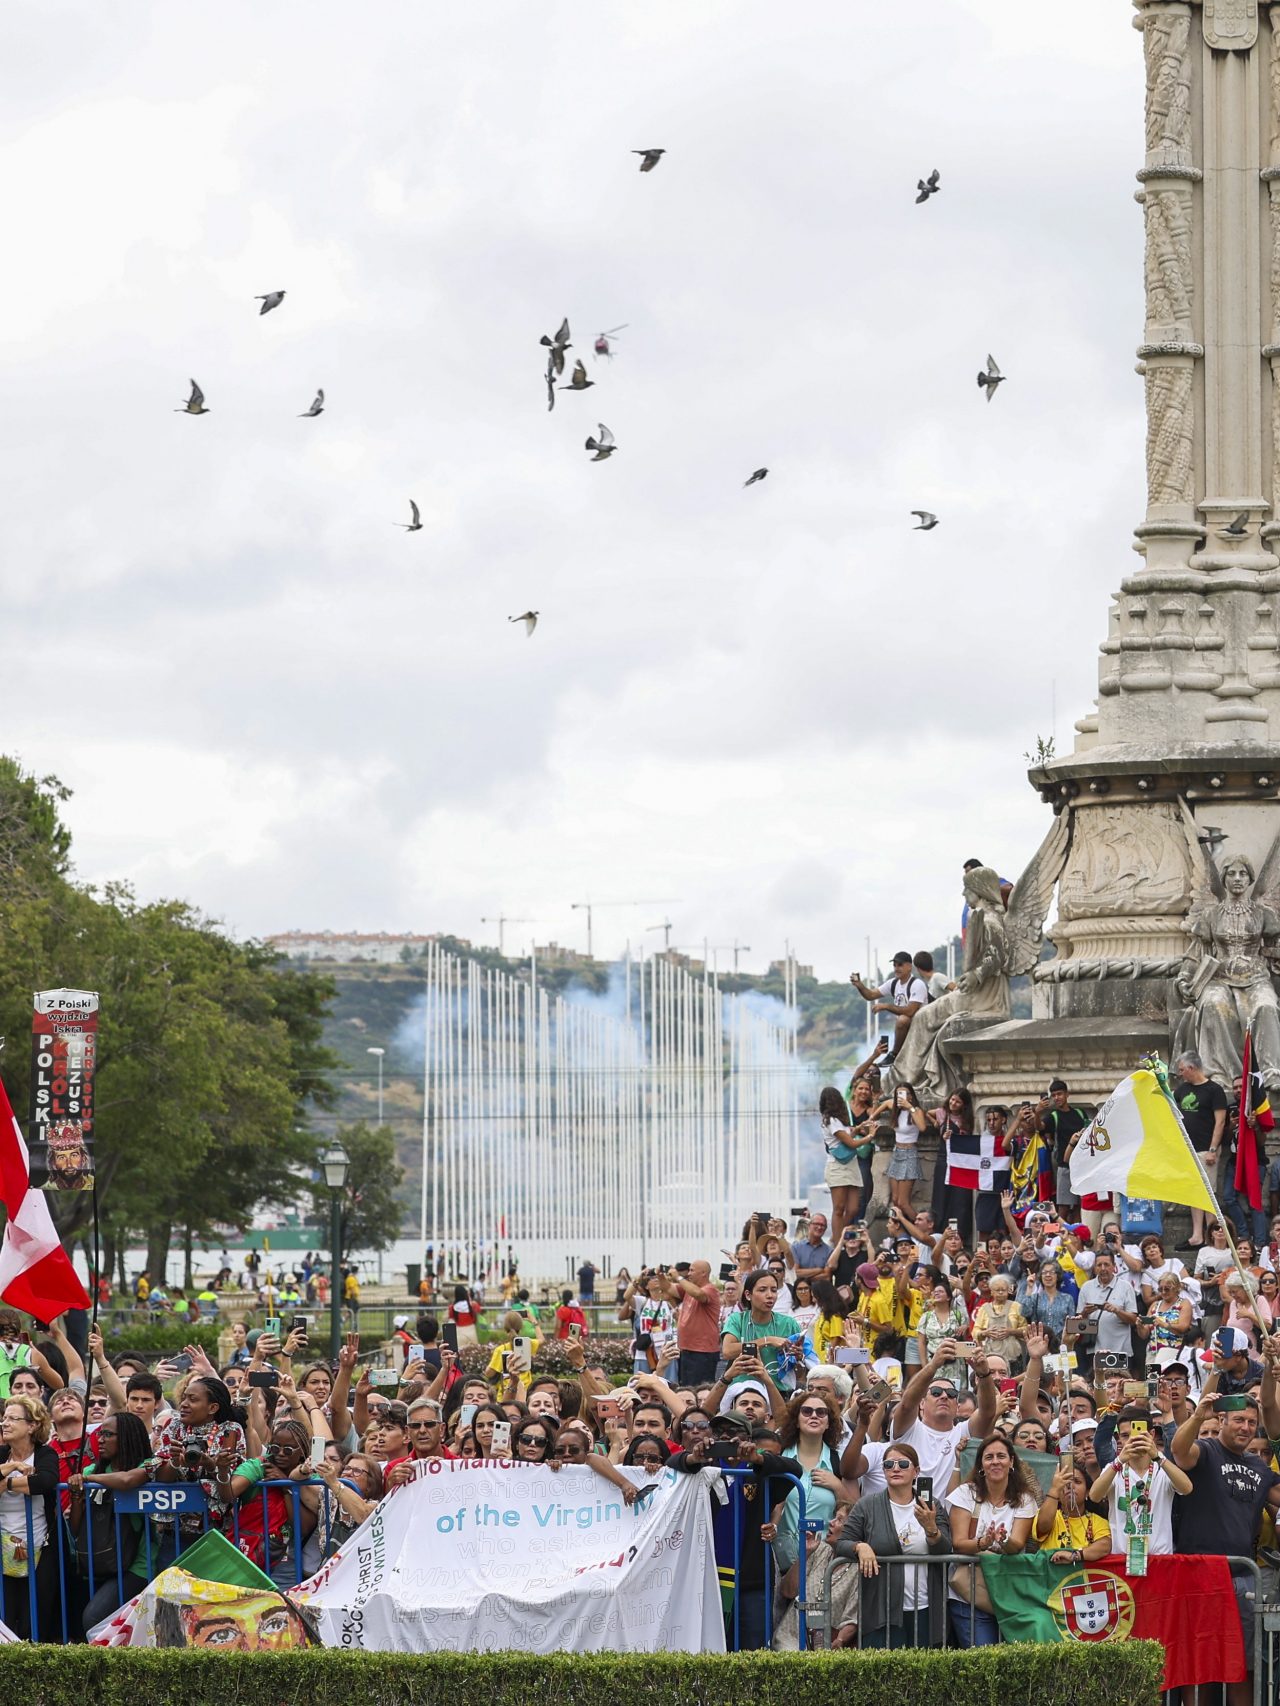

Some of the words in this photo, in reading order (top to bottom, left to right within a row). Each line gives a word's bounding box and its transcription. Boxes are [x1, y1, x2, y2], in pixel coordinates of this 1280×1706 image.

[47, 1000, 55, 1008] Z
[59, 999, 91, 1009] Polski
[47, 1012, 90, 1023] wyjdzie
[54, 1025, 83, 1033] Iskra
[35, 1034, 53, 1141] POLSKI
[68, 1041, 81, 1114] JEZUS
[81, 1034, 95, 1132] CHRYSTUS
[138, 1489, 187, 1510] PSP
[436, 1507, 466, 1534] of
[475, 1503, 521, 1527] the
[532, 1500, 621, 1529] Virgin
[371, 1502, 386, 1576] WITNESS
[457, 1530, 516, 1560] who
[528, 1527, 620, 1555] asked
[357, 1546, 372, 1593] CHRIST
[468, 1624, 499, 1651] to
[508, 1620, 549, 1647] do
